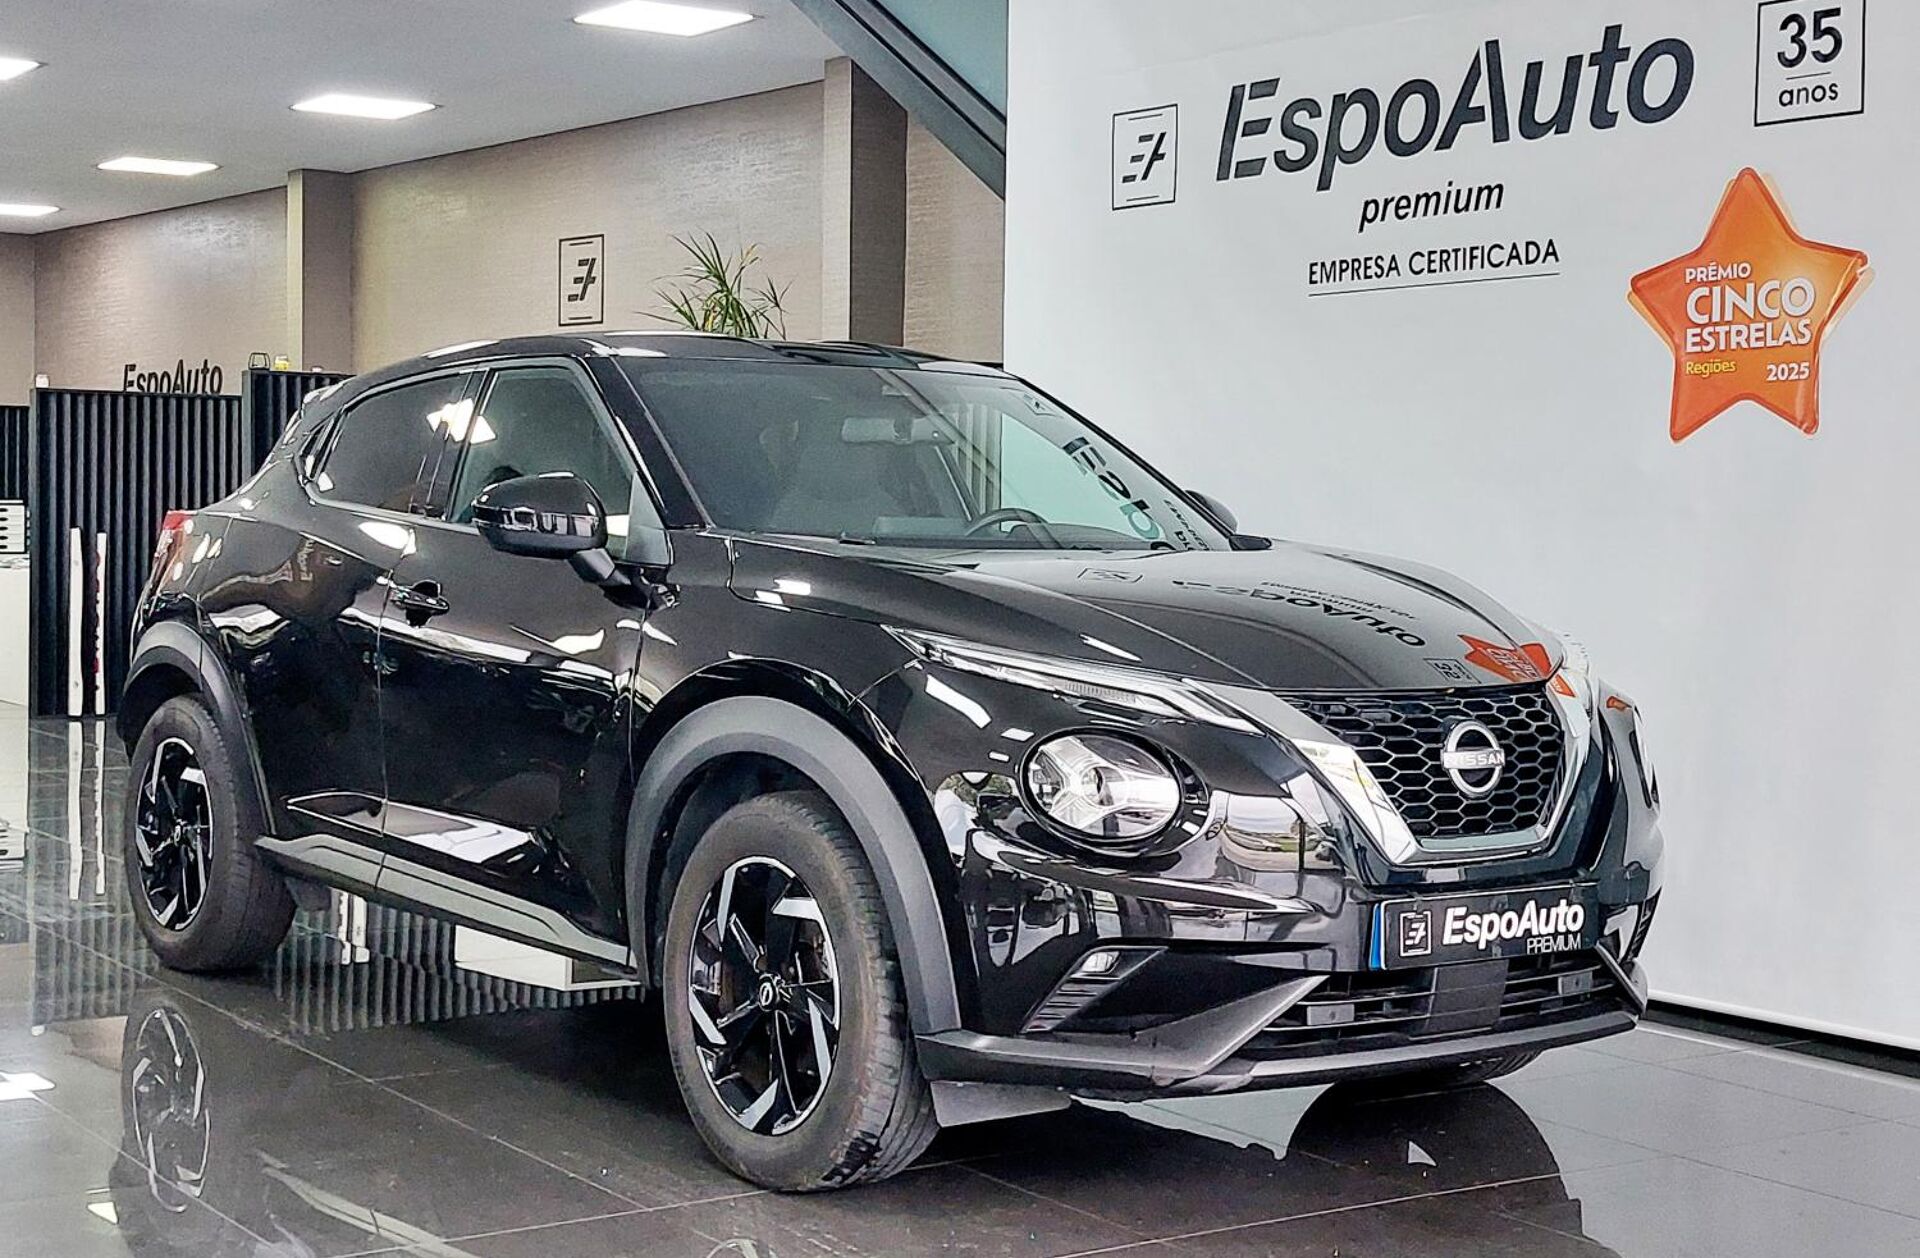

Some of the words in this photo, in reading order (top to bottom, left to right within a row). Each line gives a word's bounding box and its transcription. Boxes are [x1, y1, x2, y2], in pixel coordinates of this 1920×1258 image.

[1777, 7, 1843, 68] 35
[1216, 23, 1695, 192] EspoAuto
[1778, 83, 1838, 107] anos
[1358, 180, 1504, 232] premium
[1308, 254, 1401, 285] EMPRESA
[1408, 238, 1560, 276] CERTIFICADA
[1685, 261, 1751, 284] PRÉMIO
[1686, 277, 1816, 325] CINCO
[1685, 318, 1812, 353] ESTRELAS
[1686, 358, 1737, 378] Regiões
[1766, 361, 1810, 381] 2025
[1442, 899, 1584, 950] EspoAuto
[1526, 933, 1582, 954] PREMIUM
